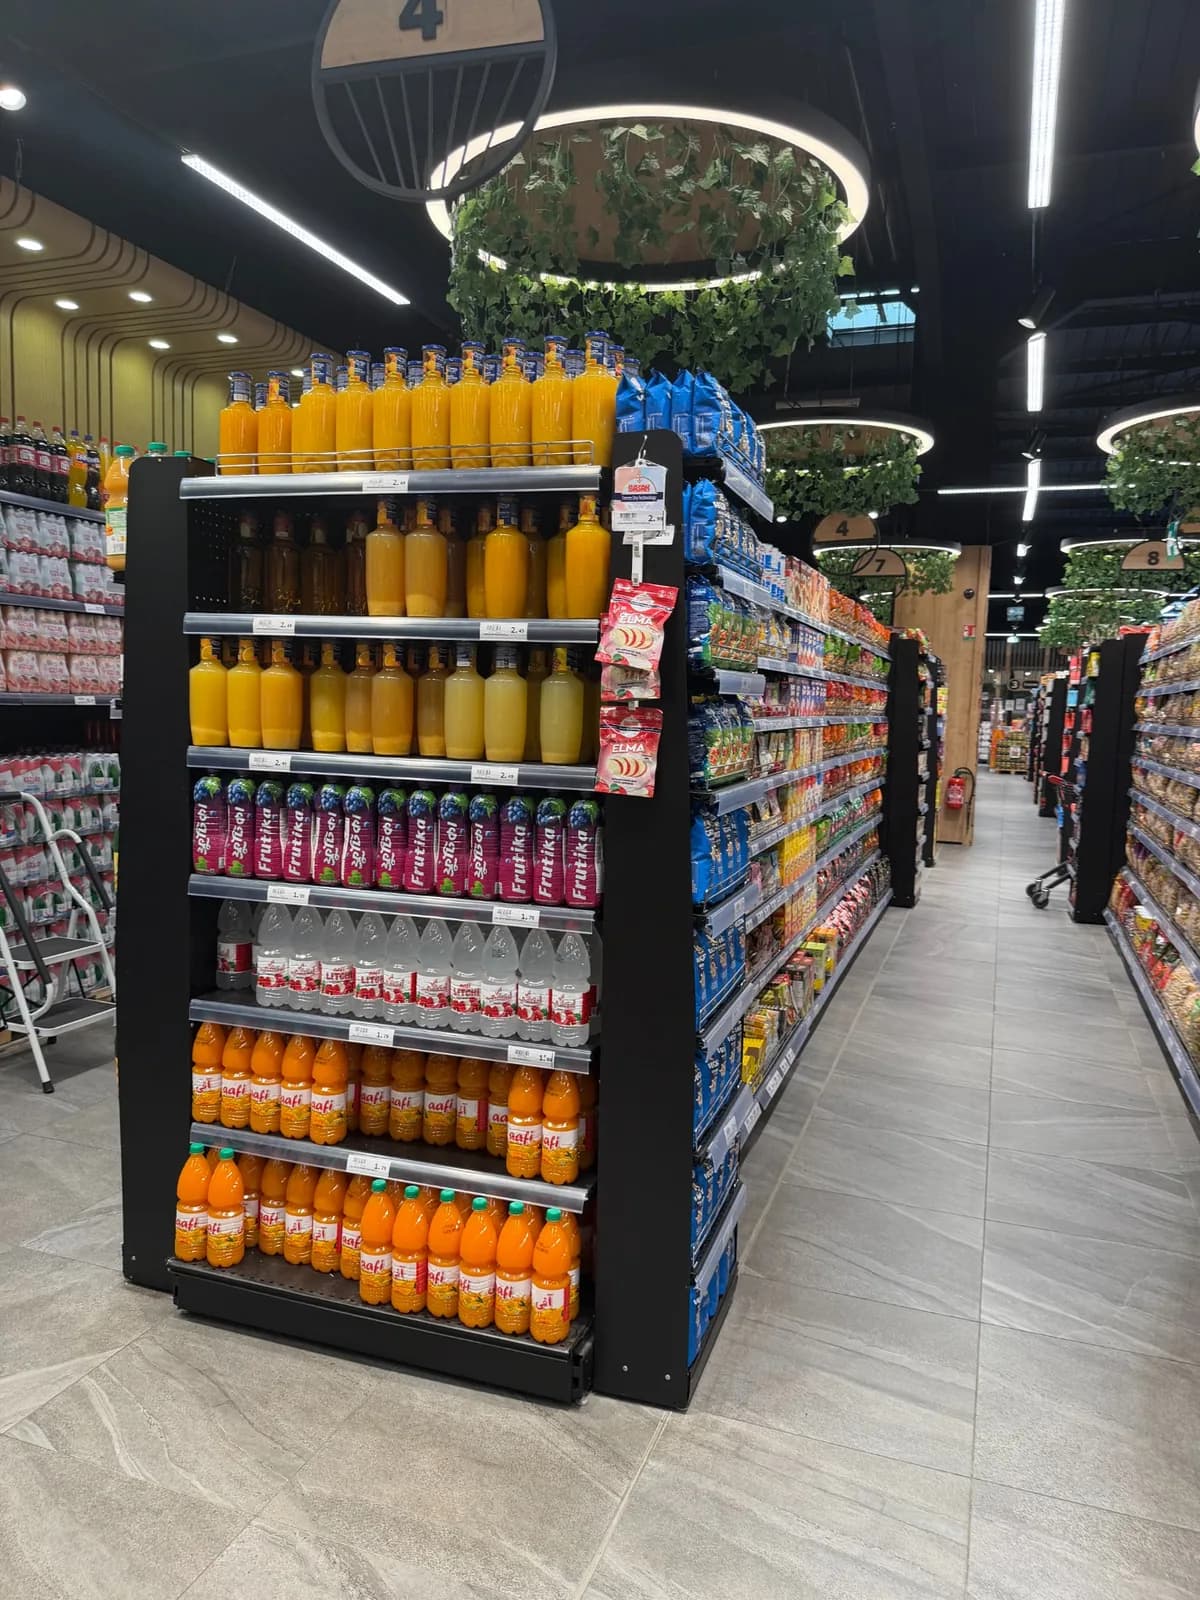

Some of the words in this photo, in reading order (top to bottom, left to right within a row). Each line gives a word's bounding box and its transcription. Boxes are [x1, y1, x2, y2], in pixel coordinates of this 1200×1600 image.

[398, 0, 444, 40] 4
[836, 520, 849, 536] 4
[875, 559, 886, 572] 7
[1148, 551, 1160, 565] 8
[619, 613, 653, 626] ELMA
[612, 743, 645, 753] ELMA
[257, 808, 272, 873] Frutika
[288, 810, 304, 876] Frutika
[411, 819, 426, 887] Frutika
[511, 825, 527, 895] Frutika
[538, 827, 556, 898] Frutika
[572, 829, 588, 900] Frutika
[428, 1099, 453, 1112] aafi
[508, 1131, 534, 1145] aafi
